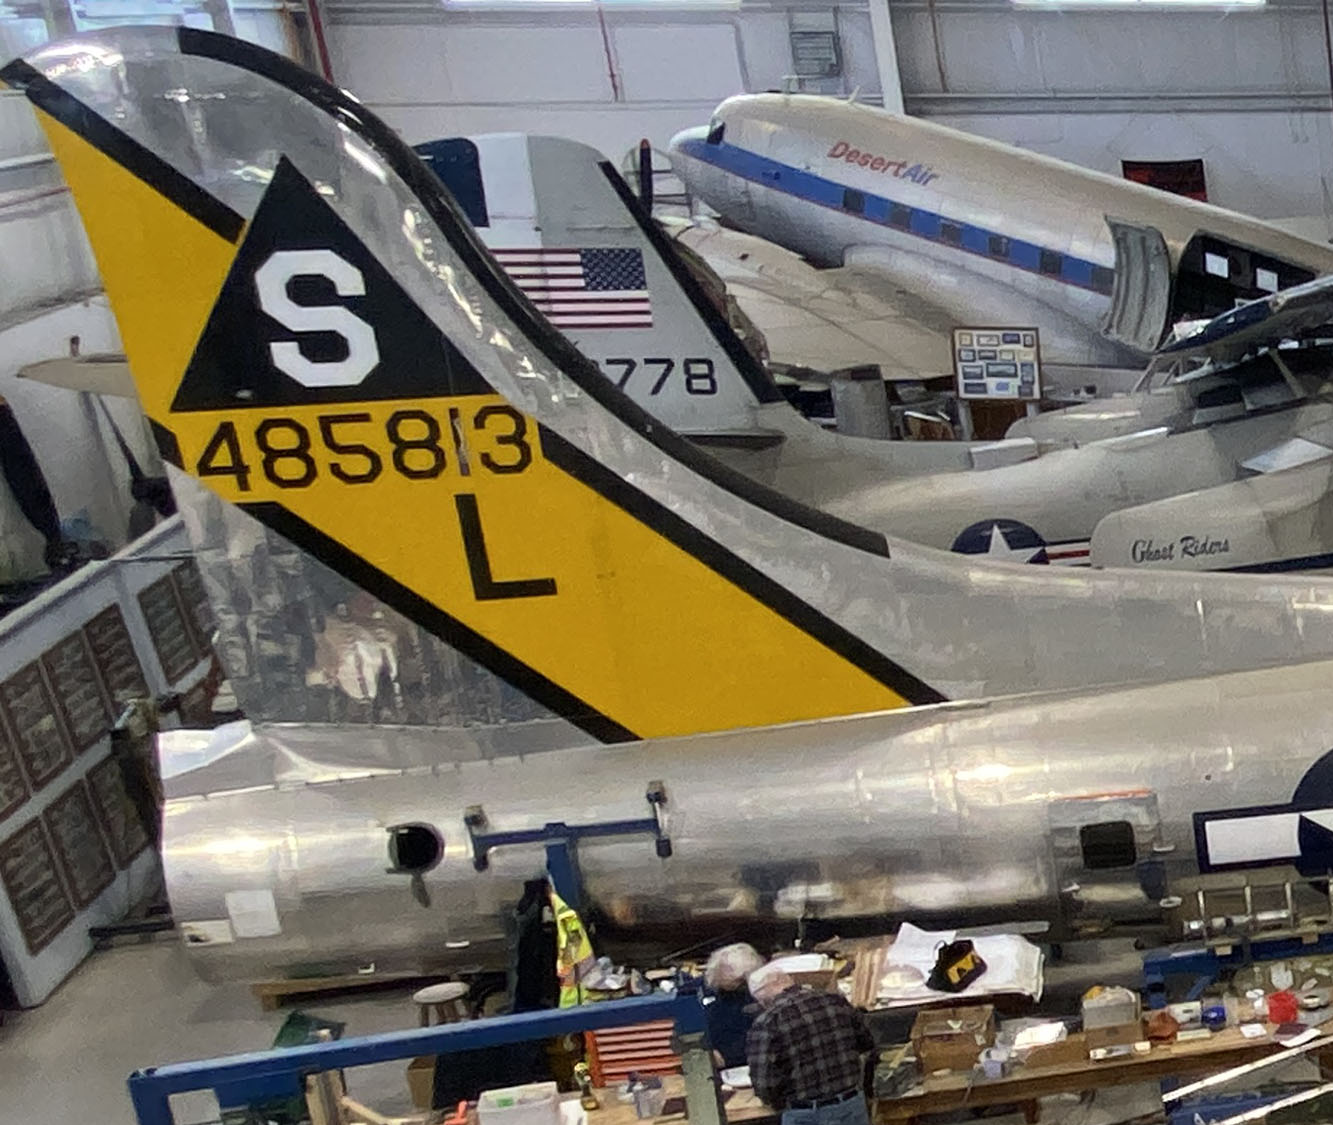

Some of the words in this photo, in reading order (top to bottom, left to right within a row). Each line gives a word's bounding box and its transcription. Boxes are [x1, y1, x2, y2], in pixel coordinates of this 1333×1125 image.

[254, 250, 380, 387] S
[590, 358, 717, 395] 778
[196, 405, 532, 491] 485813
[454, 494, 557, 601] L
